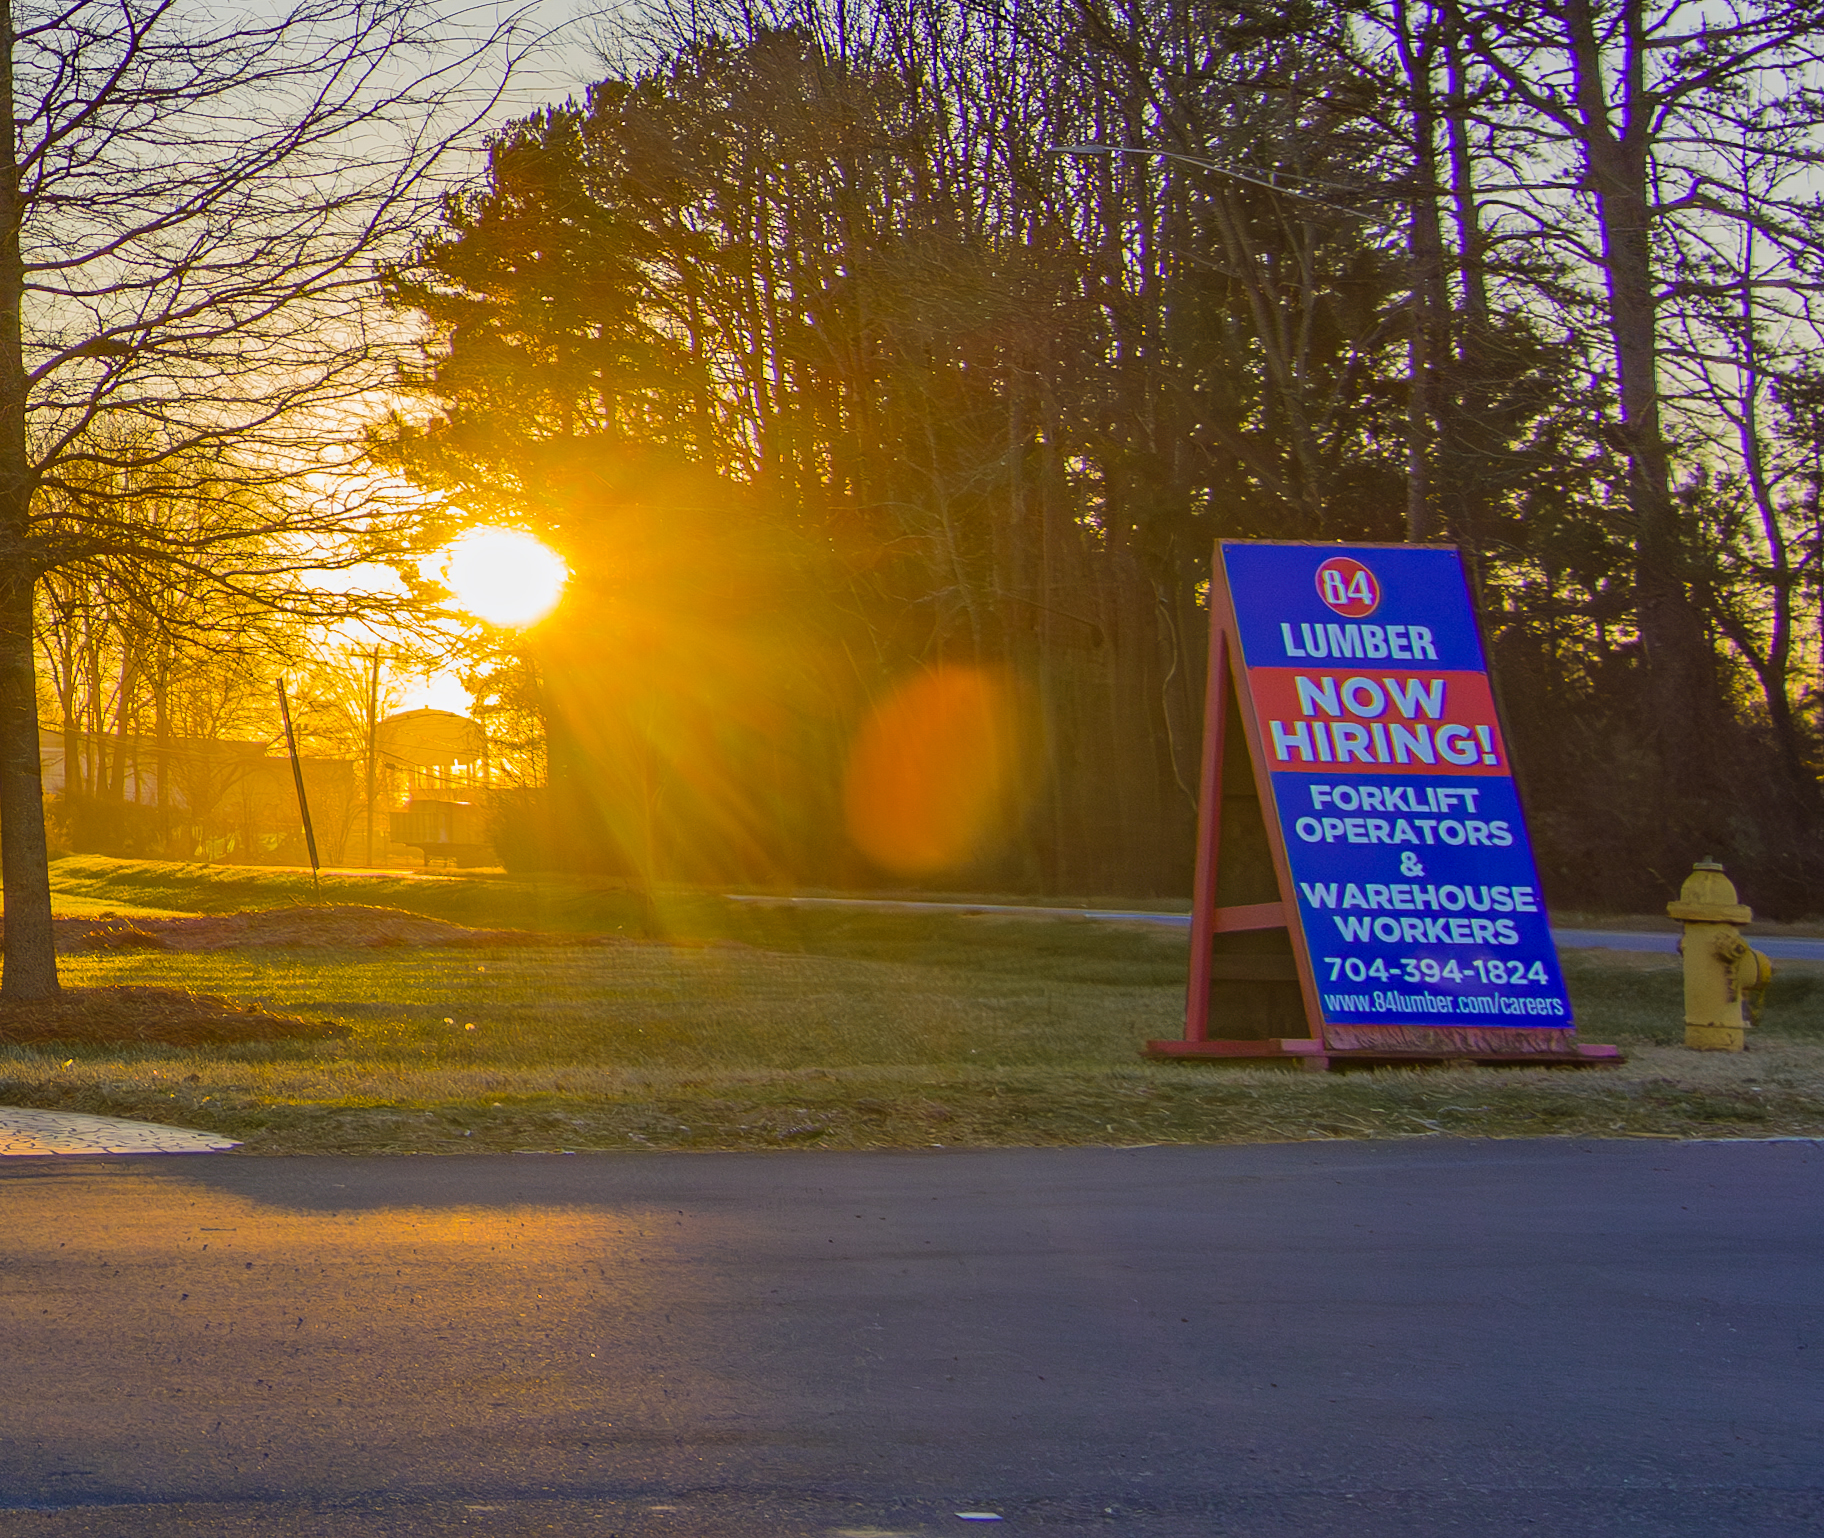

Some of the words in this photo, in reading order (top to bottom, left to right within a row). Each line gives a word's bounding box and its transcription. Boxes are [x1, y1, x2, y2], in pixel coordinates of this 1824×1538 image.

[1322, 569, 1373, 605] 84
[1279, 621, 1439, 661] LUMBER
[1295, 674, 1446, 720] NOW
[1269, 720, 1499, 766] HIRING!
[1309, 784, 1479, 813] FORKLIFT
[1295, 816, 1514, 846] OPERATORS
[1399, 851, 1426, 877] &
[1301, 882, 1538, 912] WAREHOUSE
[1333, 915, 1520, 945] WORKERS
[1323, 956, 1549, 986] 704-394-1824
[1323, 990, 1564, 1016] www.84lumber.com/careers
